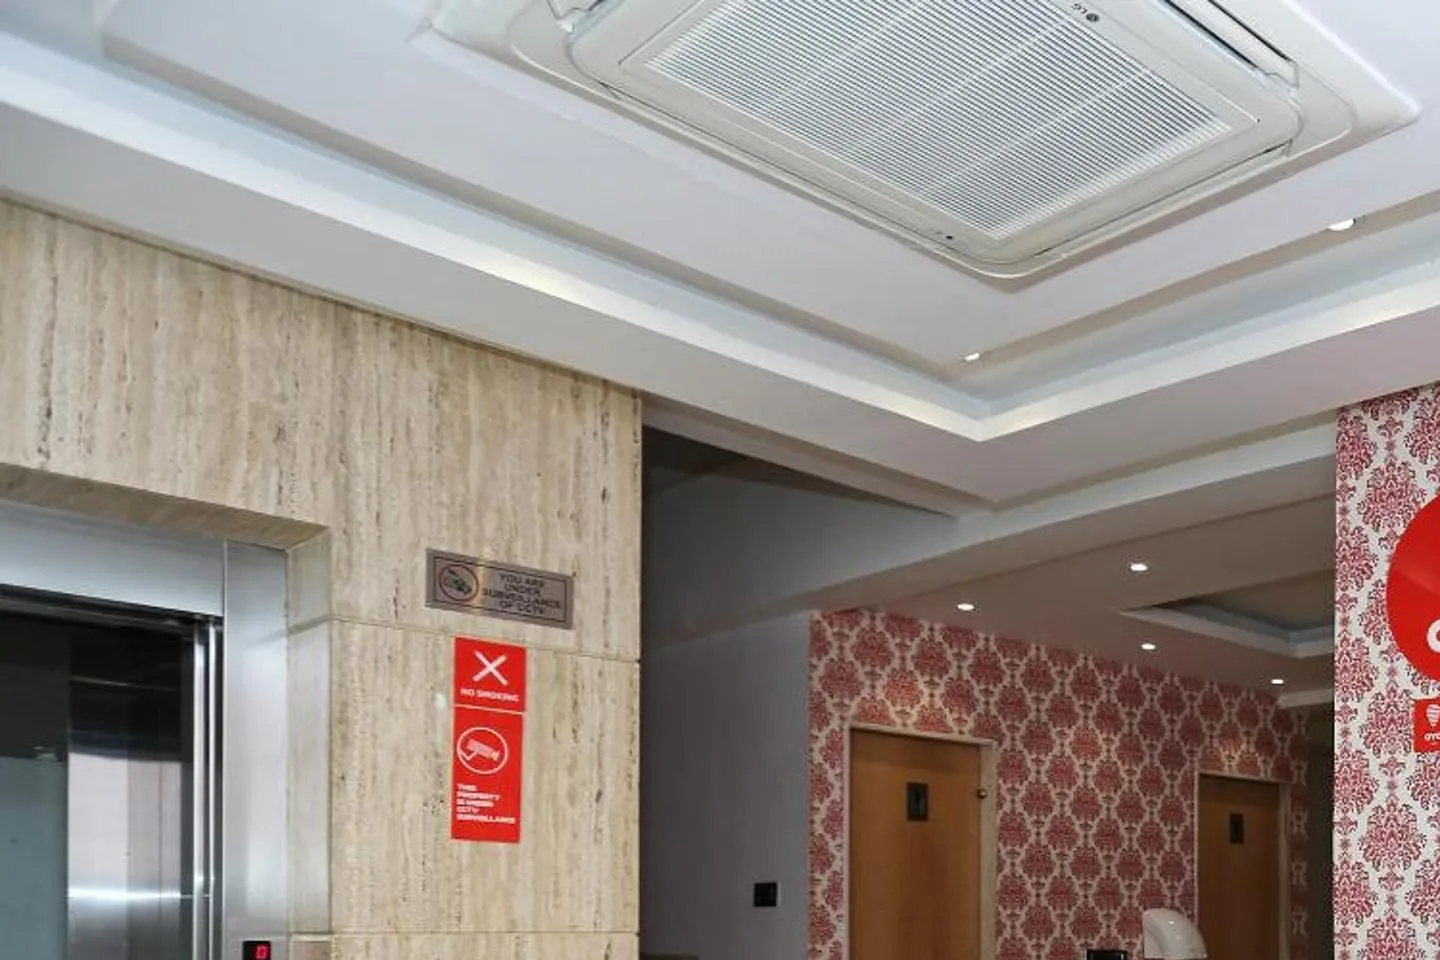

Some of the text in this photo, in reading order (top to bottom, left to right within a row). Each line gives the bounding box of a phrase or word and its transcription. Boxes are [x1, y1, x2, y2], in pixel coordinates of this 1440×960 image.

[500, 573, 522, 584] YOU
[504, 583, 542, 598] UNDER
[460, 688, 520, 702] NO SMOKING
